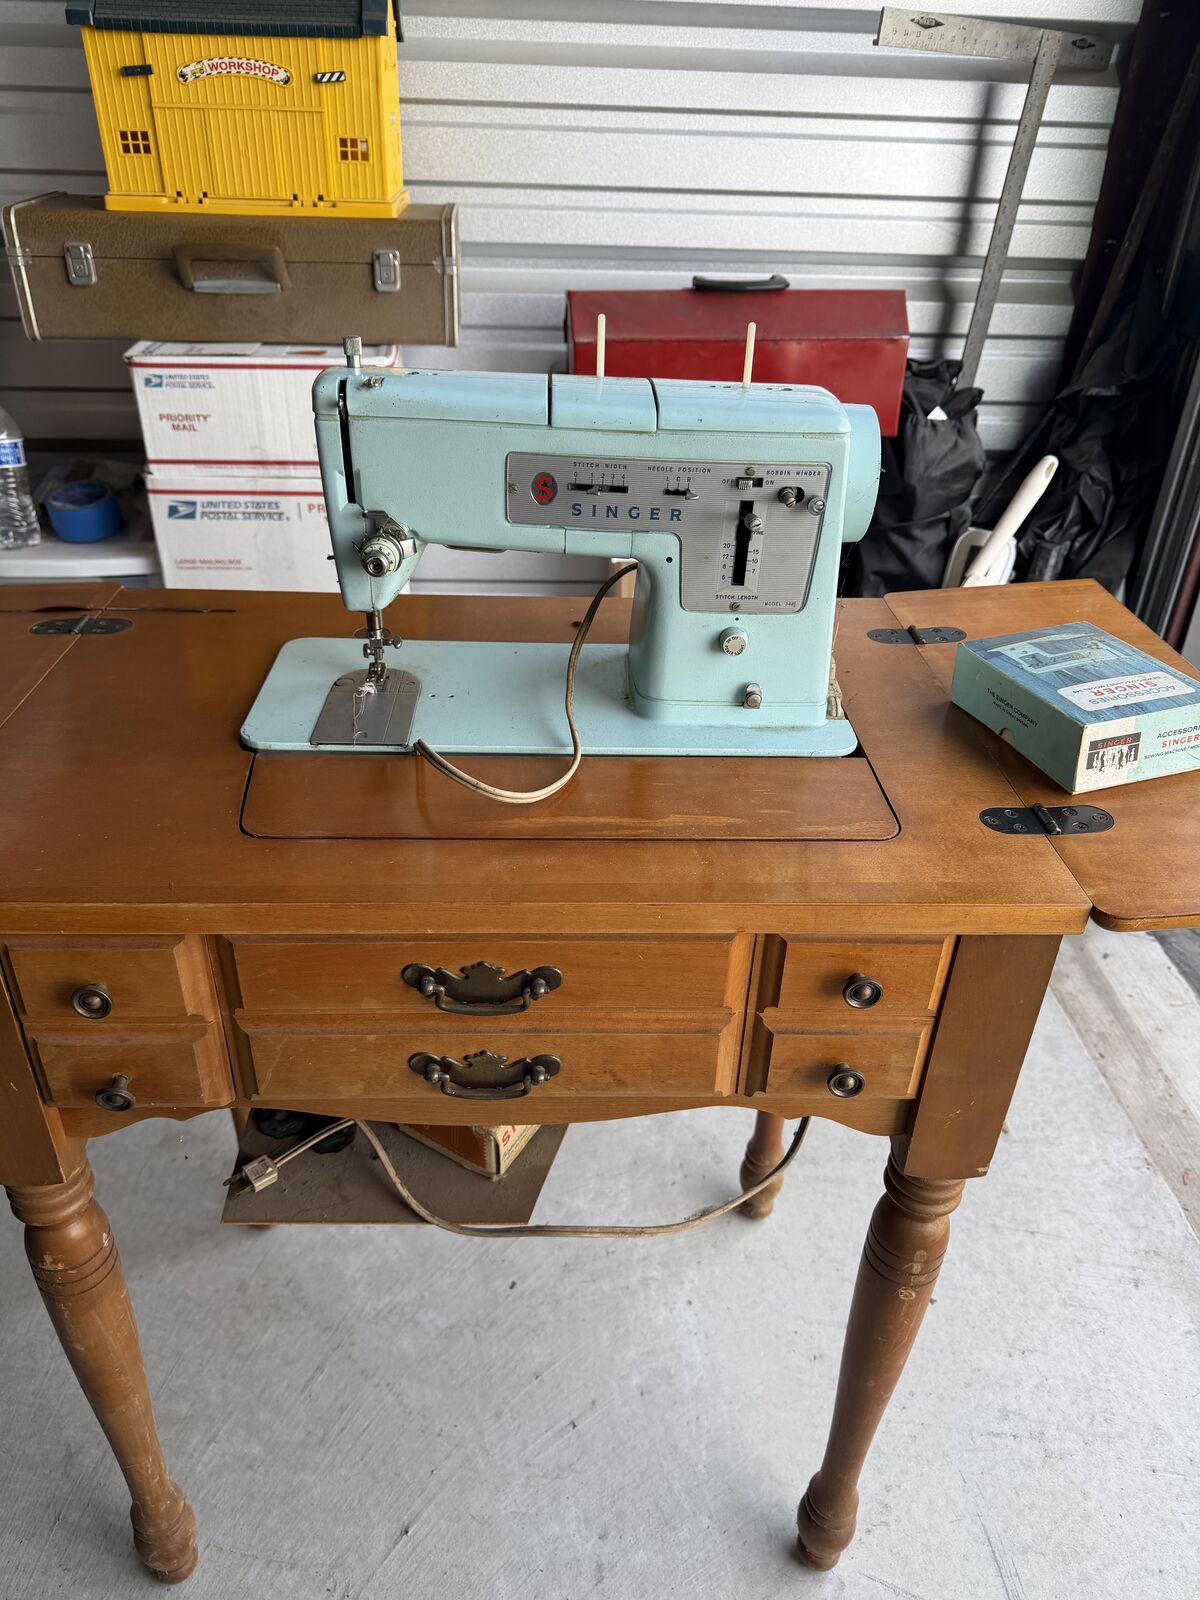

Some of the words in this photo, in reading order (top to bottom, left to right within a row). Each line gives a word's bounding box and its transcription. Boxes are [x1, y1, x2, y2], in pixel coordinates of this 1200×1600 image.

[207, 61, 279, 77] WORKSHOP
[159, 413, 209, 422] PRIORITY
[172, 423, 198, 432] MAIL
[201, 501, 242, 510] UNITED
[244, 501, 280, 510] STATES
[571, 503, 682, 522] SINGER
[201, 511, 239, 521] POSTAL
[241, 512, 285, 522] SERVICE
[1088, 685, 1176, 705] ACCESSORIES
[1090, 680, 1158, 697] SINGER
[995, 694, 1013, 709] SINGER
[1013, 707, 1038, 727] COMPANY
[1097, 737, 1133, 749] SINGER
[1161, 733, 1200, 748] SINGER
[1144, 751, 1164, 760] SEWING
[1164, 746, 1187, 756] MACHINE
